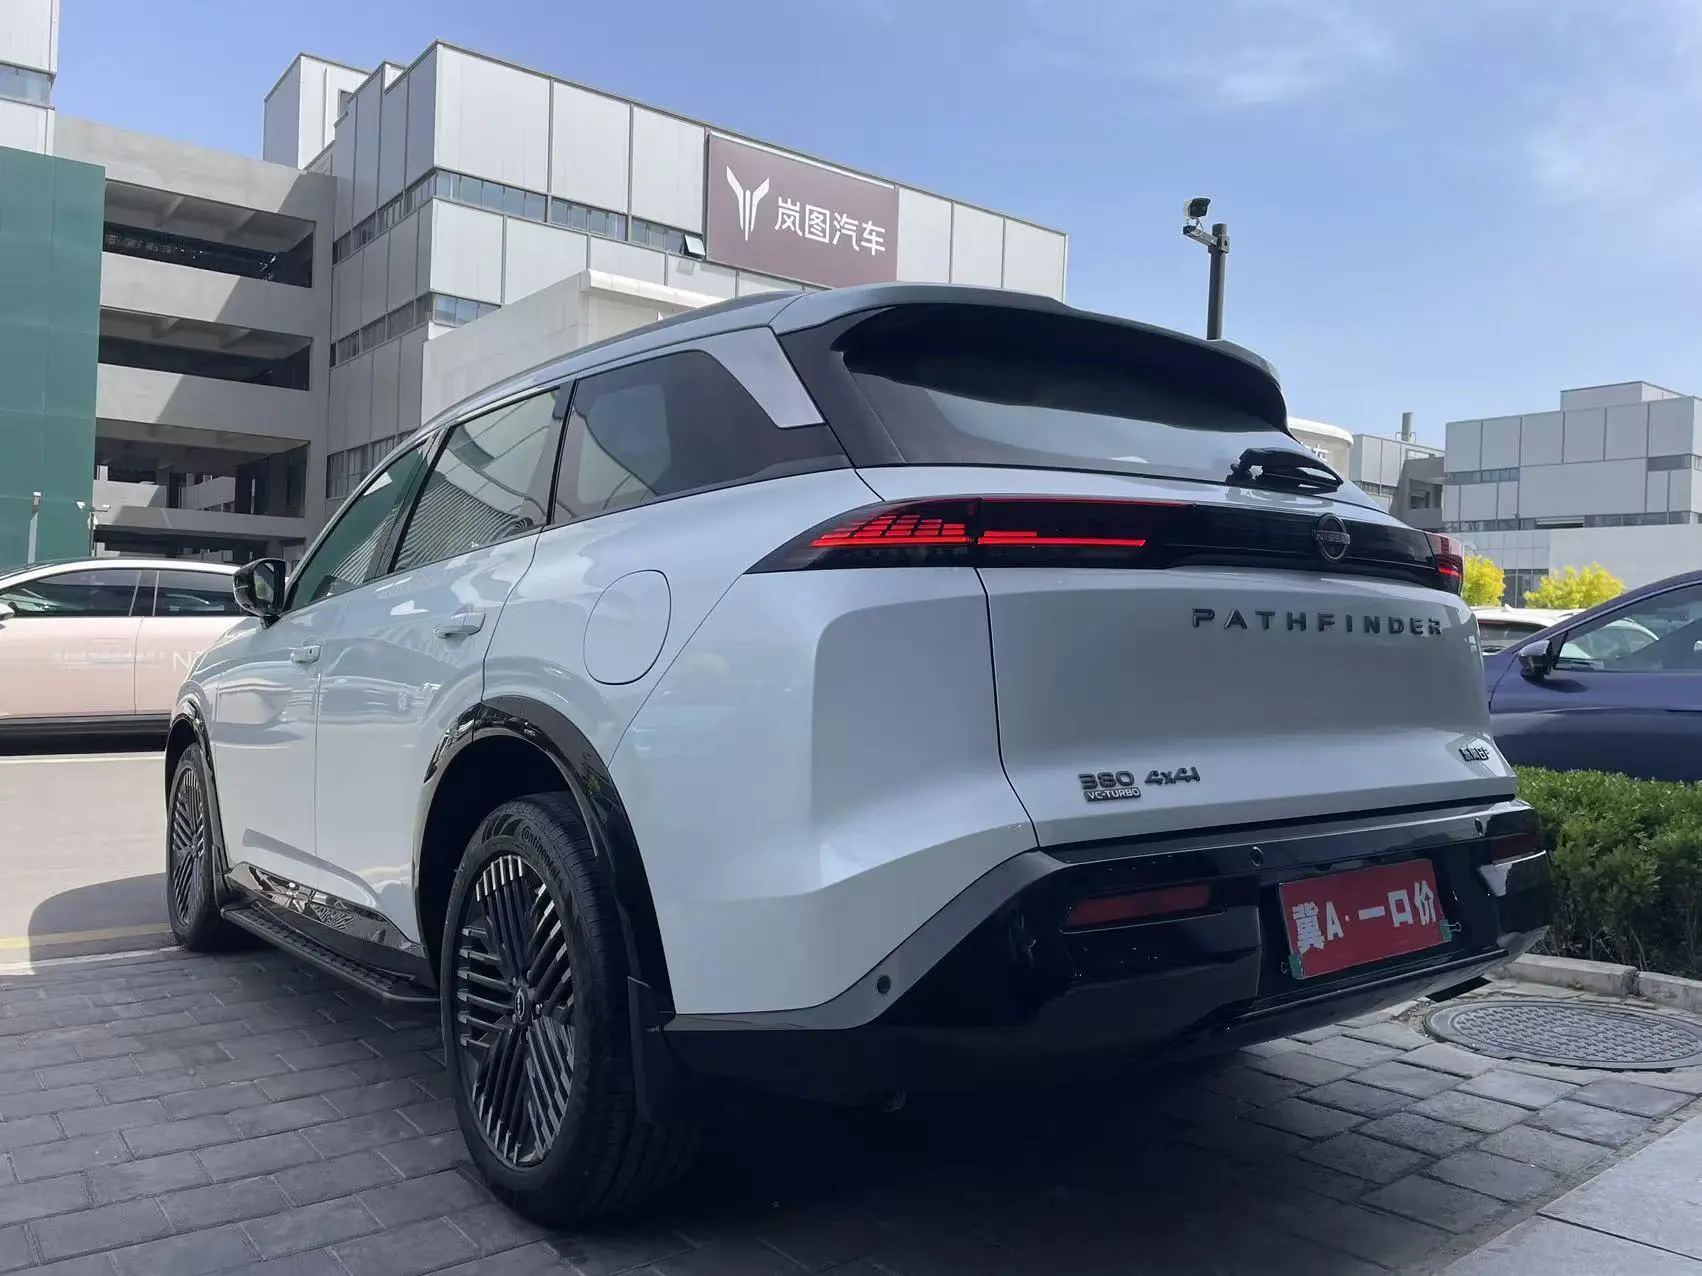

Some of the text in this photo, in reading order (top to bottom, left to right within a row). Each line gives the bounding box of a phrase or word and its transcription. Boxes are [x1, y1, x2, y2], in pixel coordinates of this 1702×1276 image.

[774, 196, 886, 256] 岚图汽车
[1192, 608, 1442, 636] PATHFINDER
[1078, 770, 1135, 790] 380
[1087, 787, 1141, 800] VC-TURBO
